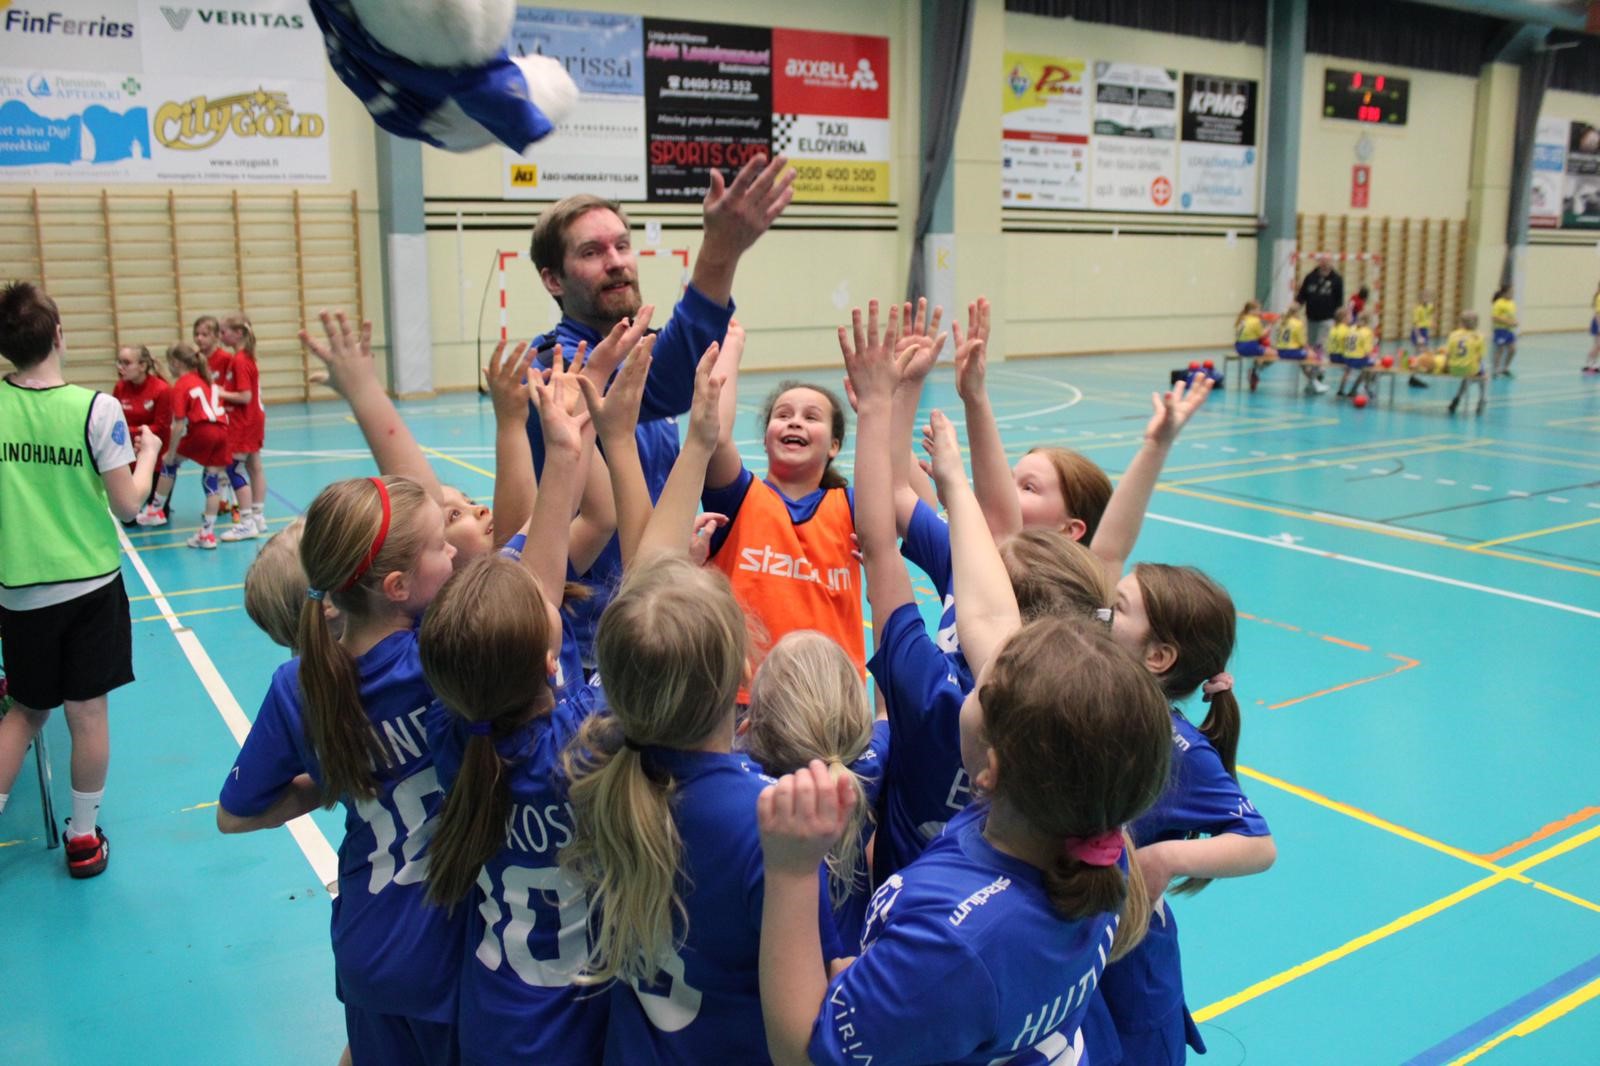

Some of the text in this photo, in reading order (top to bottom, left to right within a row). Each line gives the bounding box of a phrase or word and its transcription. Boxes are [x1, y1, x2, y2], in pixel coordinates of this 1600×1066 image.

[6, 9, 135, 38] FinFerries
[198, 9, 304, 29] VERITAS
[515, 43, 632, 78] Mrissa
[785, 58, 848, 80] axxell
[1188, 90, 1247, 118] KPMG
[816, 122, 848, 137] TAXI
[651, 140, 722, 166] SPORTS
[826, 167, 850, 181] 400
[853, 168, 877, 182] 500
[0, 442, 84, 467] INOHJAAJA
[949, 876, 1011, 926] stadium
